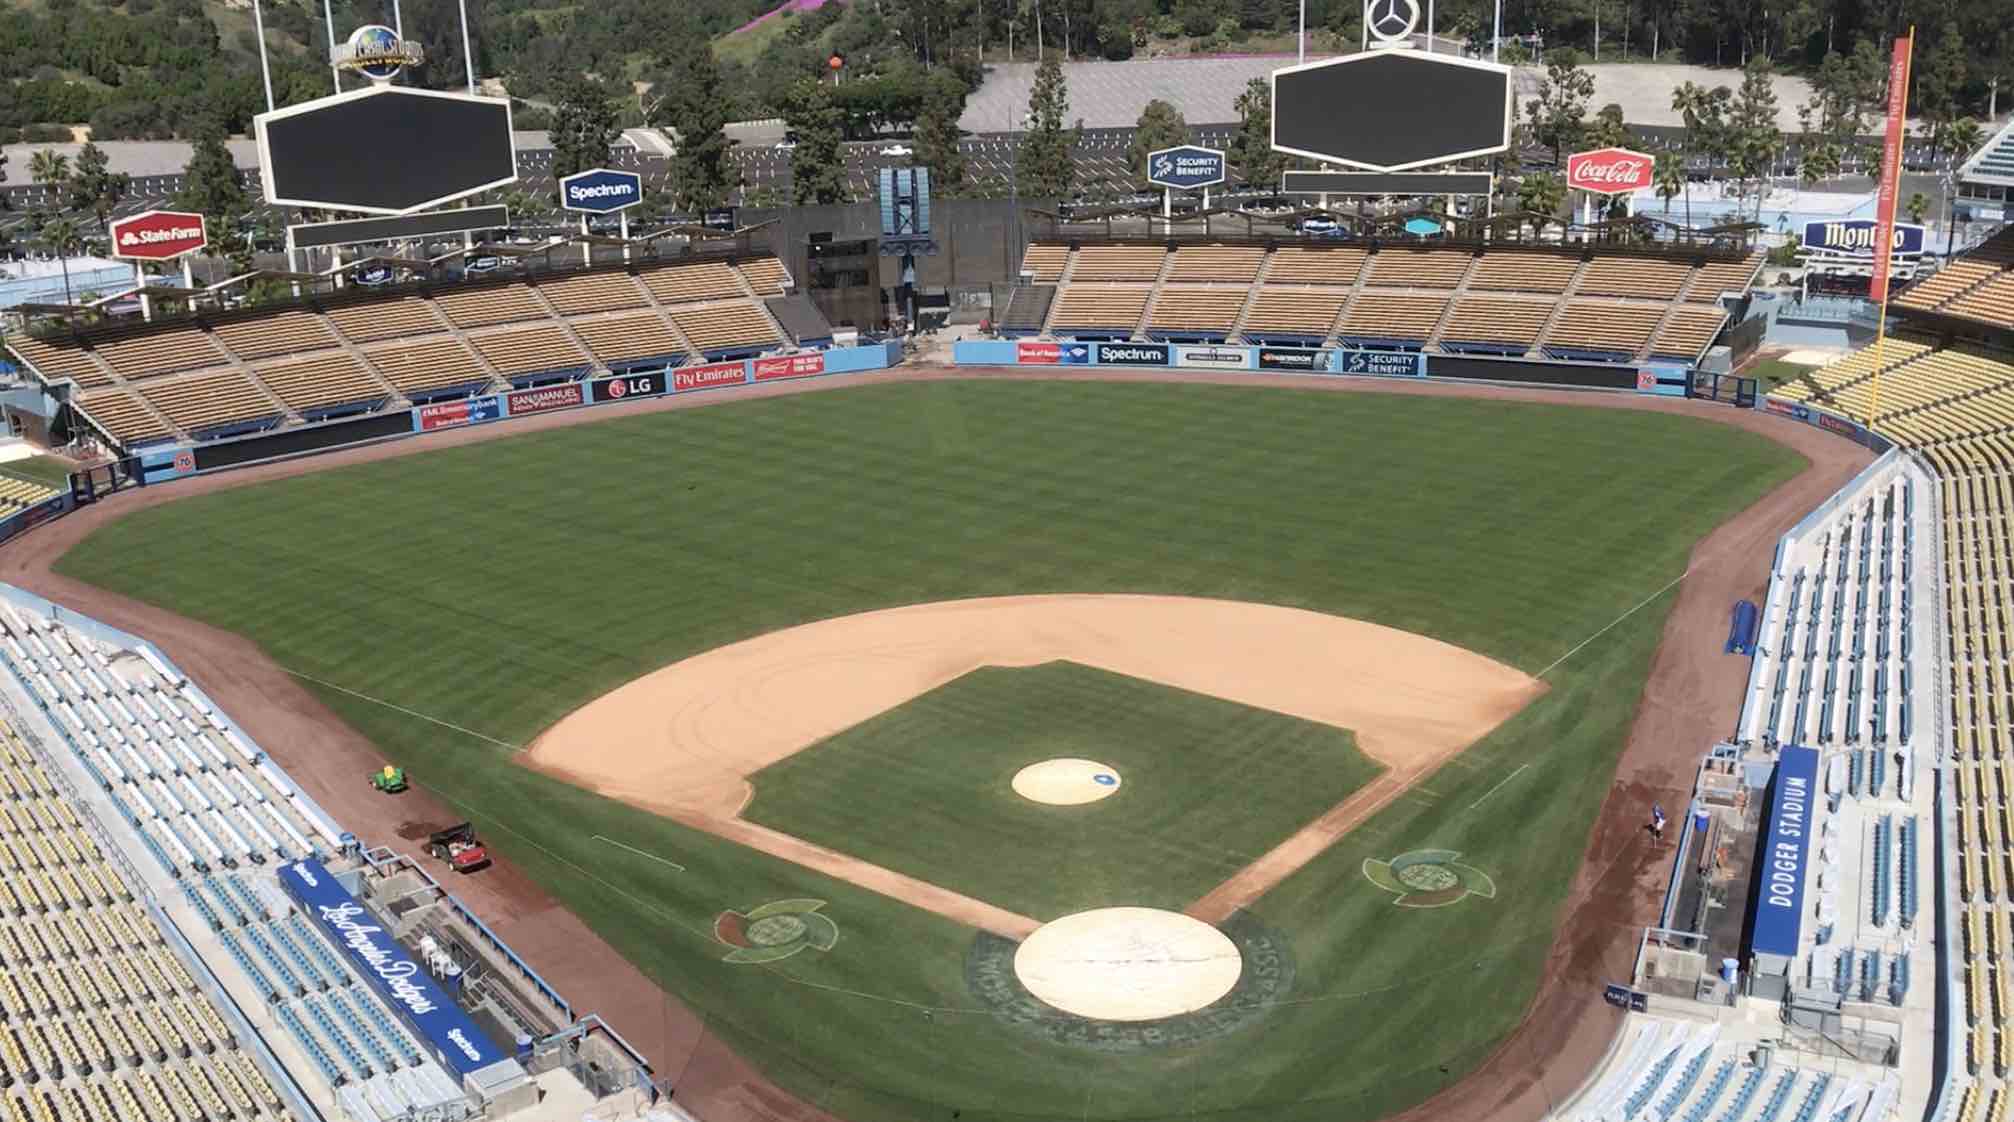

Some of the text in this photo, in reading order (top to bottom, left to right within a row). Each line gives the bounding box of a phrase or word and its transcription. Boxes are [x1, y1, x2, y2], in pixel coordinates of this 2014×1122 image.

[1175, 157, 1218, 167] SECURITY
[569, 183, 633, 202] Spectrum
[139, 227, 201, 244] State Farm
[1824, 223, 1905, 249] Monto
[1101, 345, 1162, 362] Spectrum
[1368, 353, 1413, 365] SECURITY
[629, 377, 652, 394] LG
[676, 371, 695, 387] Fly
[695, 365, 745, 383] Emirates
[511, 395, 530, 407] SAN
[541, 388, 578, 403] MANUEL
[1768, 776, 1808, 908] DODGER STADIUM
[292, 862, 318, 888] Spectrum
[318, 902, 439, 1015] Los Angeles Dodgers
[447, 1027, 481, 1062] Spectrum
